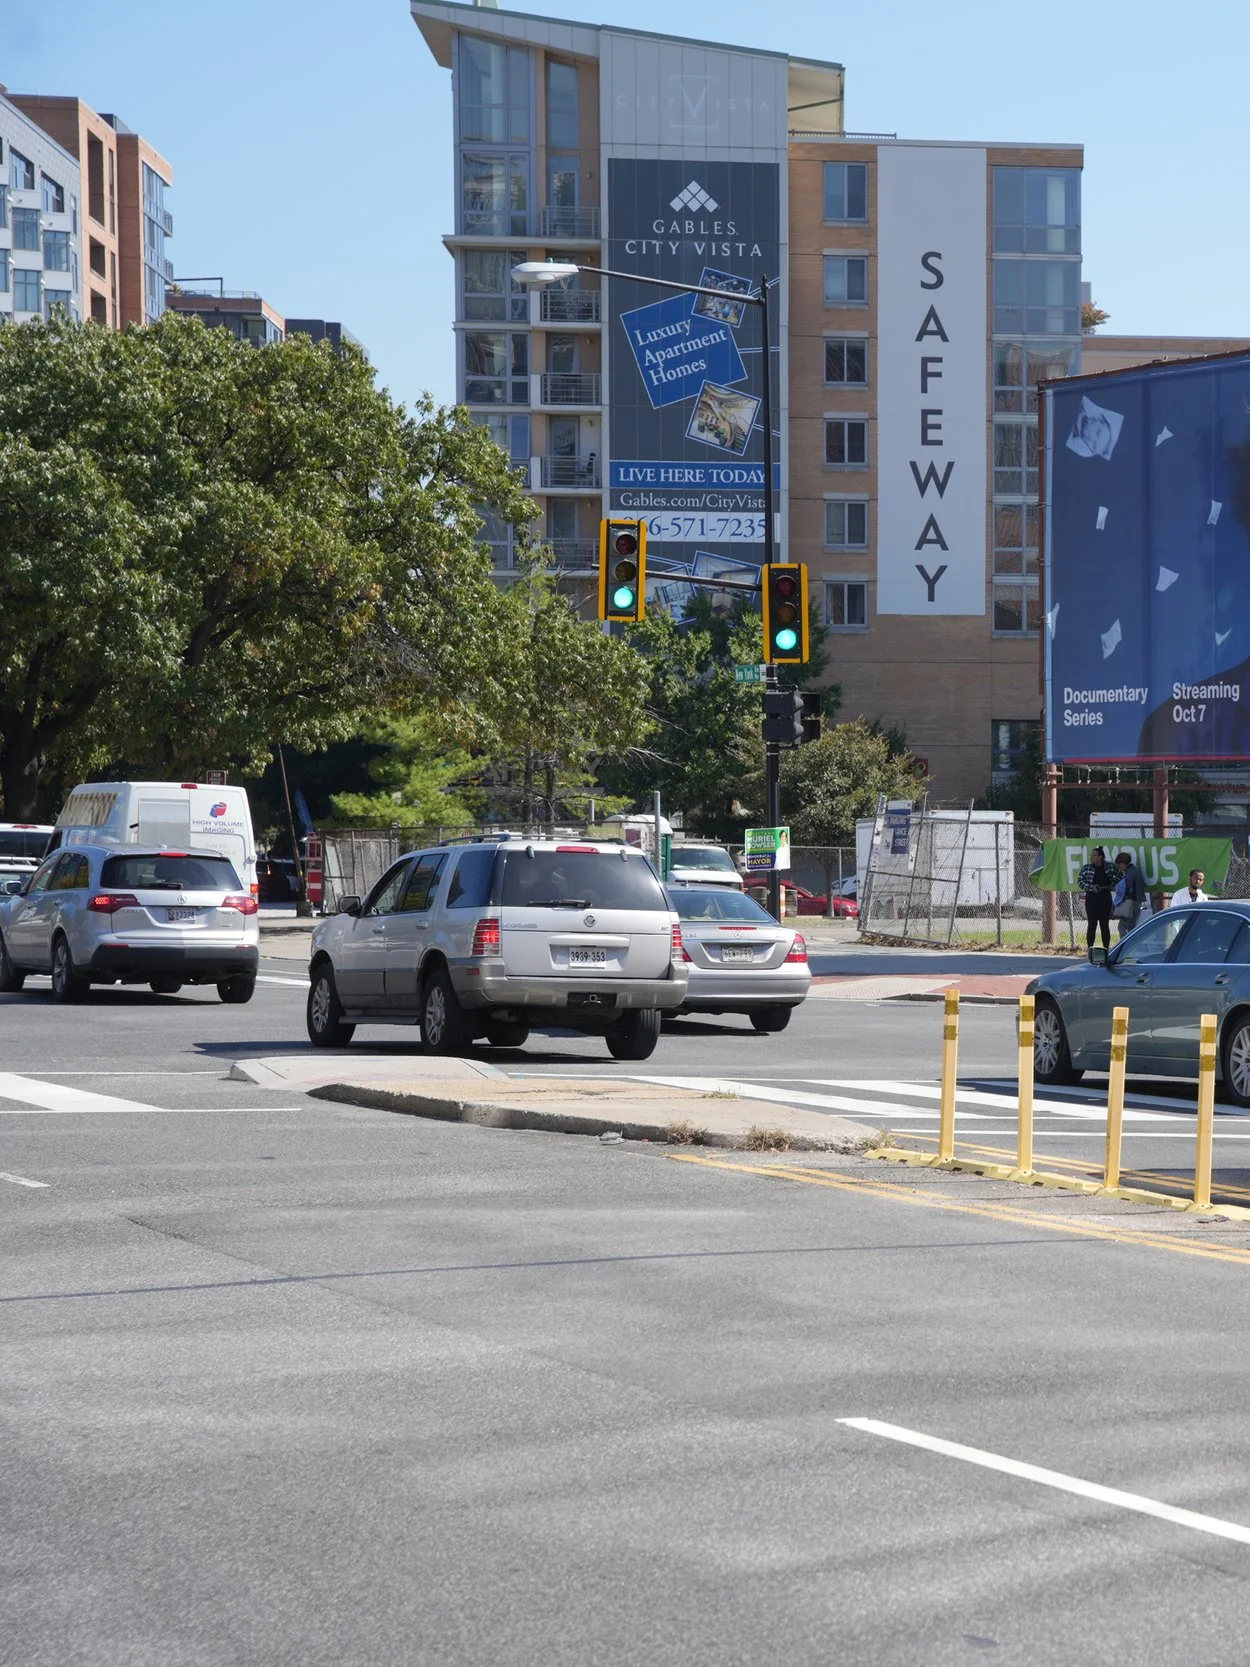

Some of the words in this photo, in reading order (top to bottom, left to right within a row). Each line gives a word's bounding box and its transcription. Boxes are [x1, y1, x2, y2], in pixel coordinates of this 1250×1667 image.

[616, 94, 675, 108] CITY
[653, 219, 736, 235] GABLES
[625, 239, 680, 255] CITY
[694, 241, 762, 257] VISTA
[634, 319, 691, 346] Luxury
[644, 329, 728, 368] Apartment
[649, 359, 707, 386] Homes
[904, 251, 955, 602] SAFEWAY
[619, 468, 656, 482] LIVE
[660, 469, 706, 483] HERE
[624, 514, 765, 538] 6-571-7235
[1064, 686, 1148, 704] Documentary
[1173, 681, 1240, 702] Streaming
[1064, 709, 1103, 727] Series
[1173, 705, 1196, 723] Oct
[1198, 704, 1206, 722] 7
